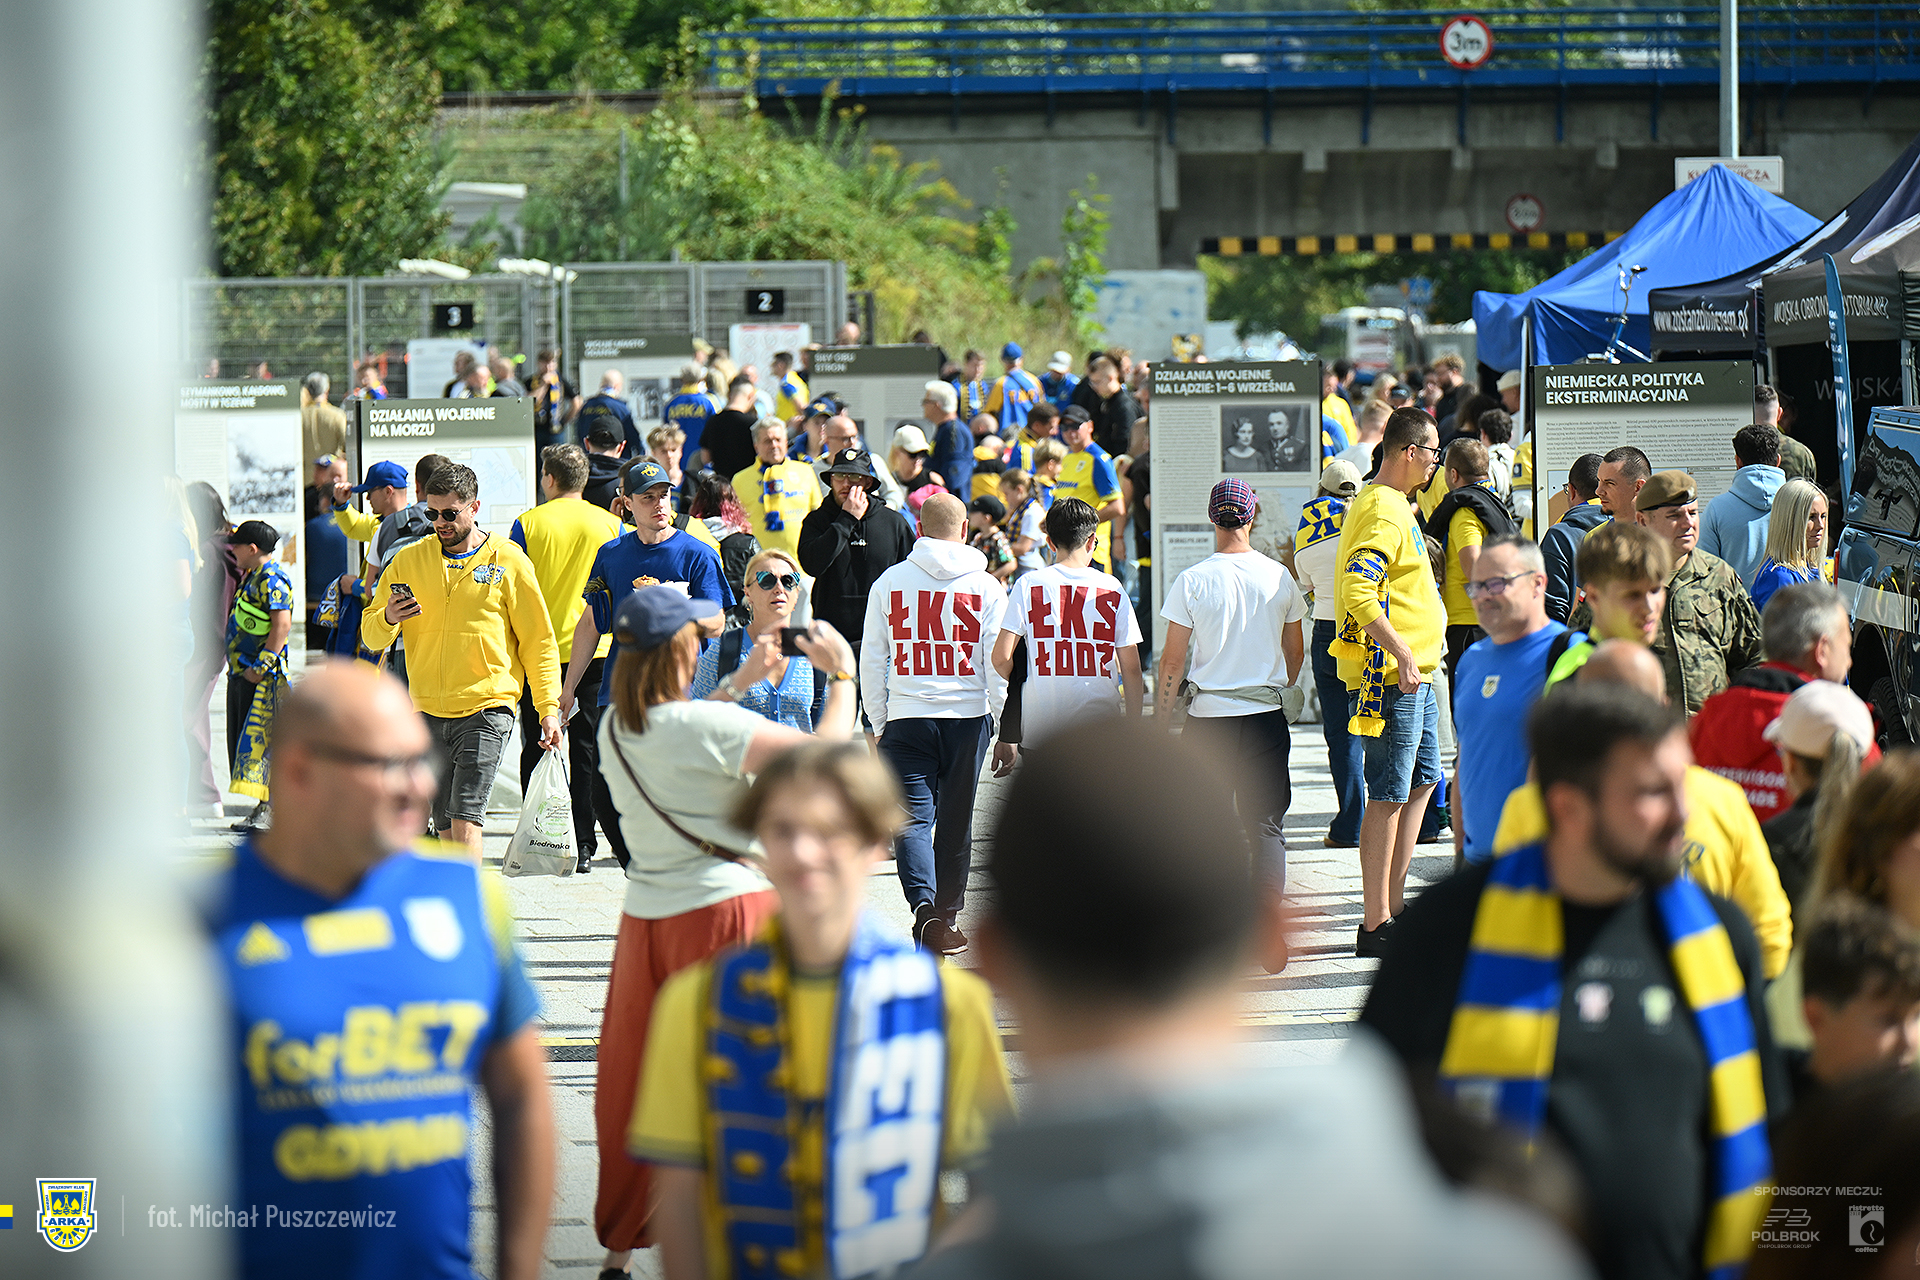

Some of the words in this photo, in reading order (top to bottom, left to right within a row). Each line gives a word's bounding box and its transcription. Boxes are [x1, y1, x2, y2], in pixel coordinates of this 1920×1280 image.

[757, 292, 773, 312] 2
[447, 305, 462, 327] 3
[1155, 369, 1214, 381] DZIAŁANIA
[1215, 369, 1272, 380] WOJENNE
[1545, 373, 1629, 389] NIEMIECKA
[1632, 372, 1705, 387] POLITYKA
[1155, 383, 1172, 394] NA
[1238, 379, 1295, 393] WRZEŚNIA
[1814, 376, 1902, 402] WJSKA
[1545, 388, 1689, 405] EKSTERMINACYJNA
[369, 408, 435, 423] DZIAŁANIA
[436, 406, 496, 421] WOJENNE
[369, 424, 387, 438] NA
[389, 422, 435, 437] MORZU
[888, 590, 982, 643] ŁKS
[1028, 585, 1121, 642] ŁKS
[529, 840, 570, 850] Biedronka
